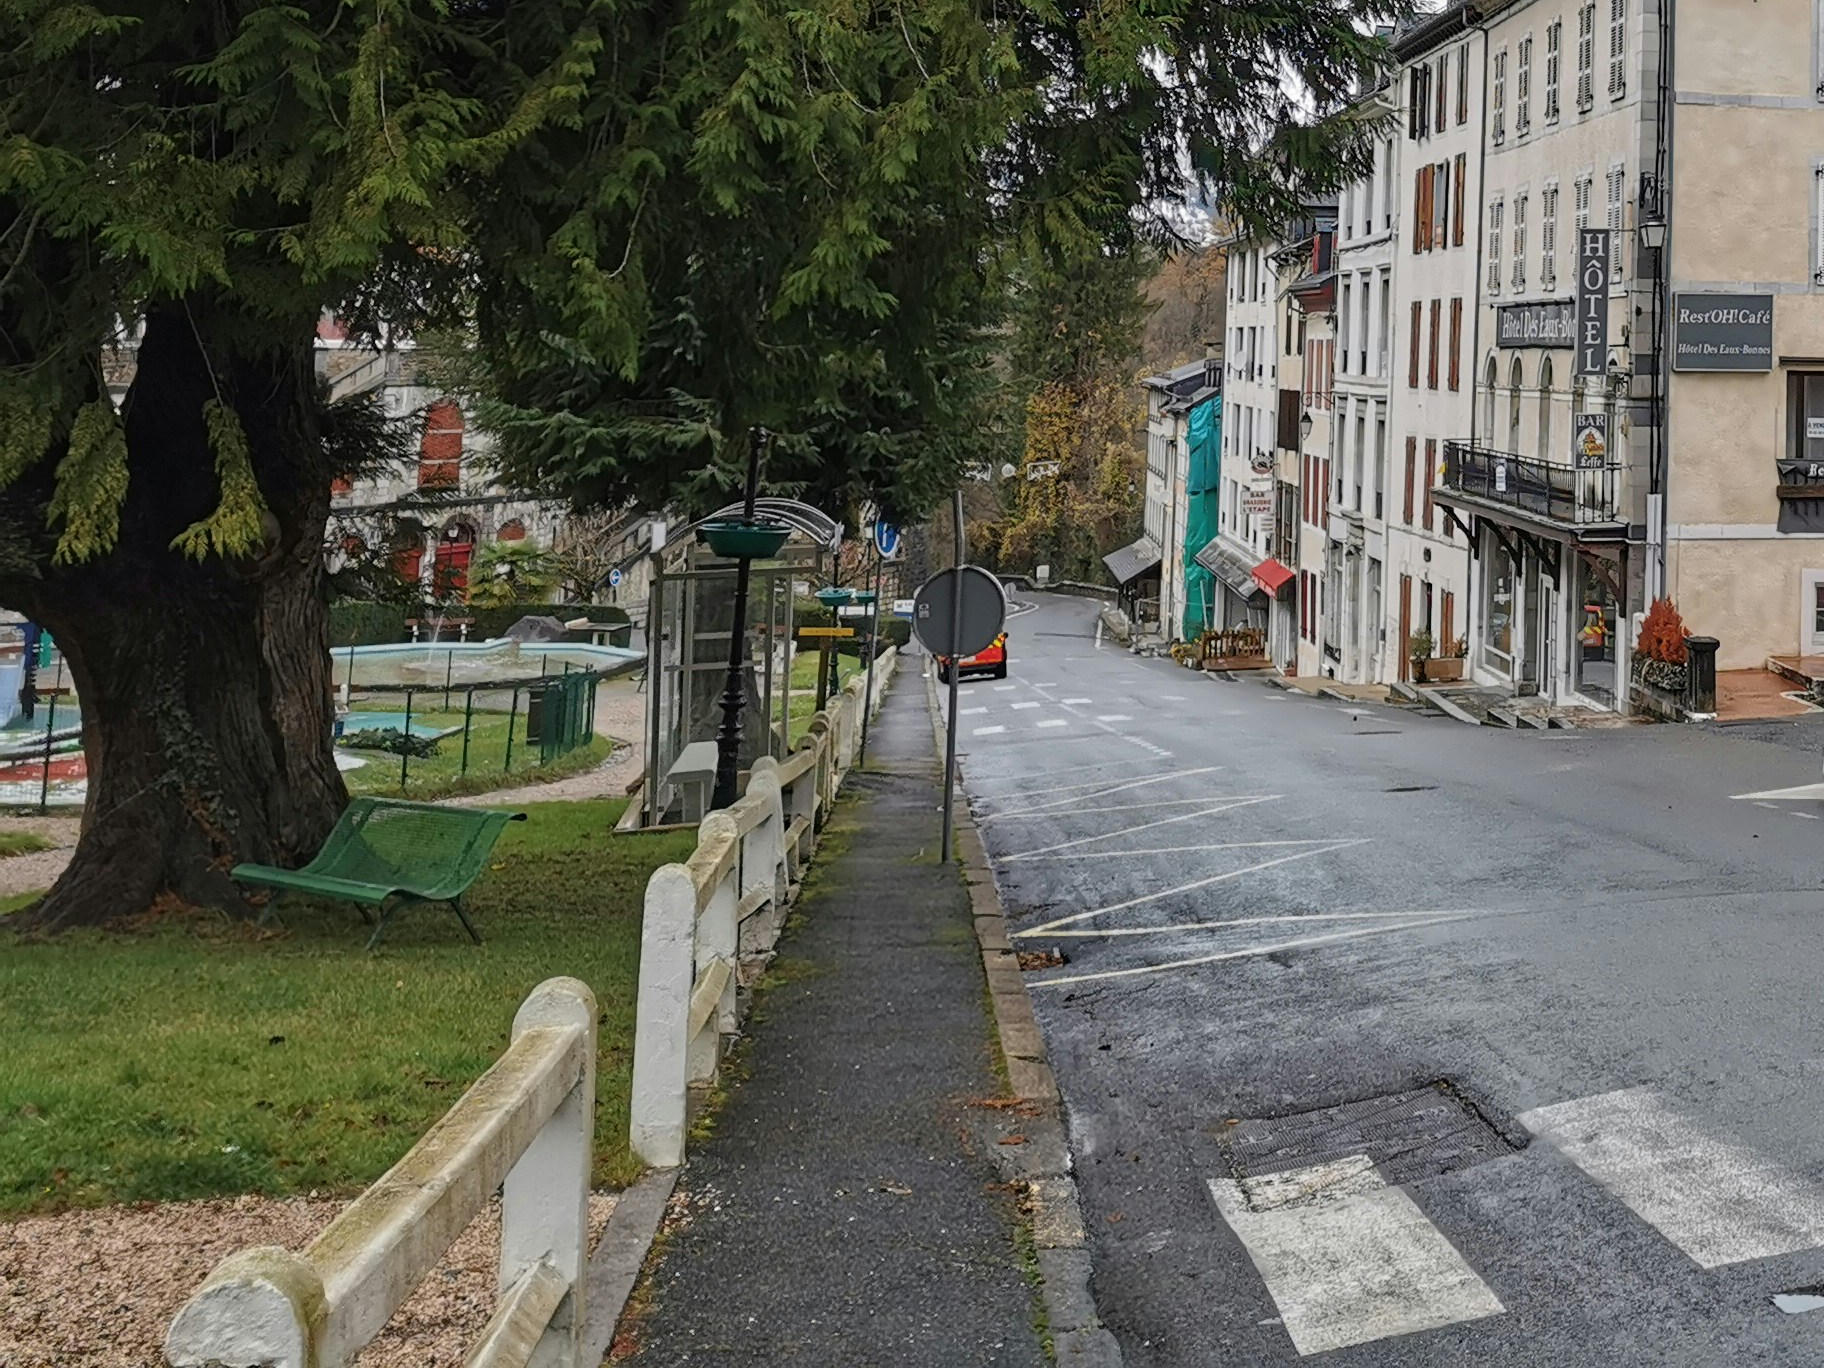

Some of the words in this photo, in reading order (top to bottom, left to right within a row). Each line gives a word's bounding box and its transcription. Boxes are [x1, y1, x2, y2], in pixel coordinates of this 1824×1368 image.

[1582, 234, 1605, 372] HÔTEL
[1502, 311, 1523, 338] Hôtel
[1678, 343, 1702, 354] Hôtel
[1703, 344, 1717, 355] Des
[1720, 344, 1770, 354] Eaux-Bonnes
[1577, 415, 1604, 426] BAR
[1580, 456, 1602, 467] Leffe
